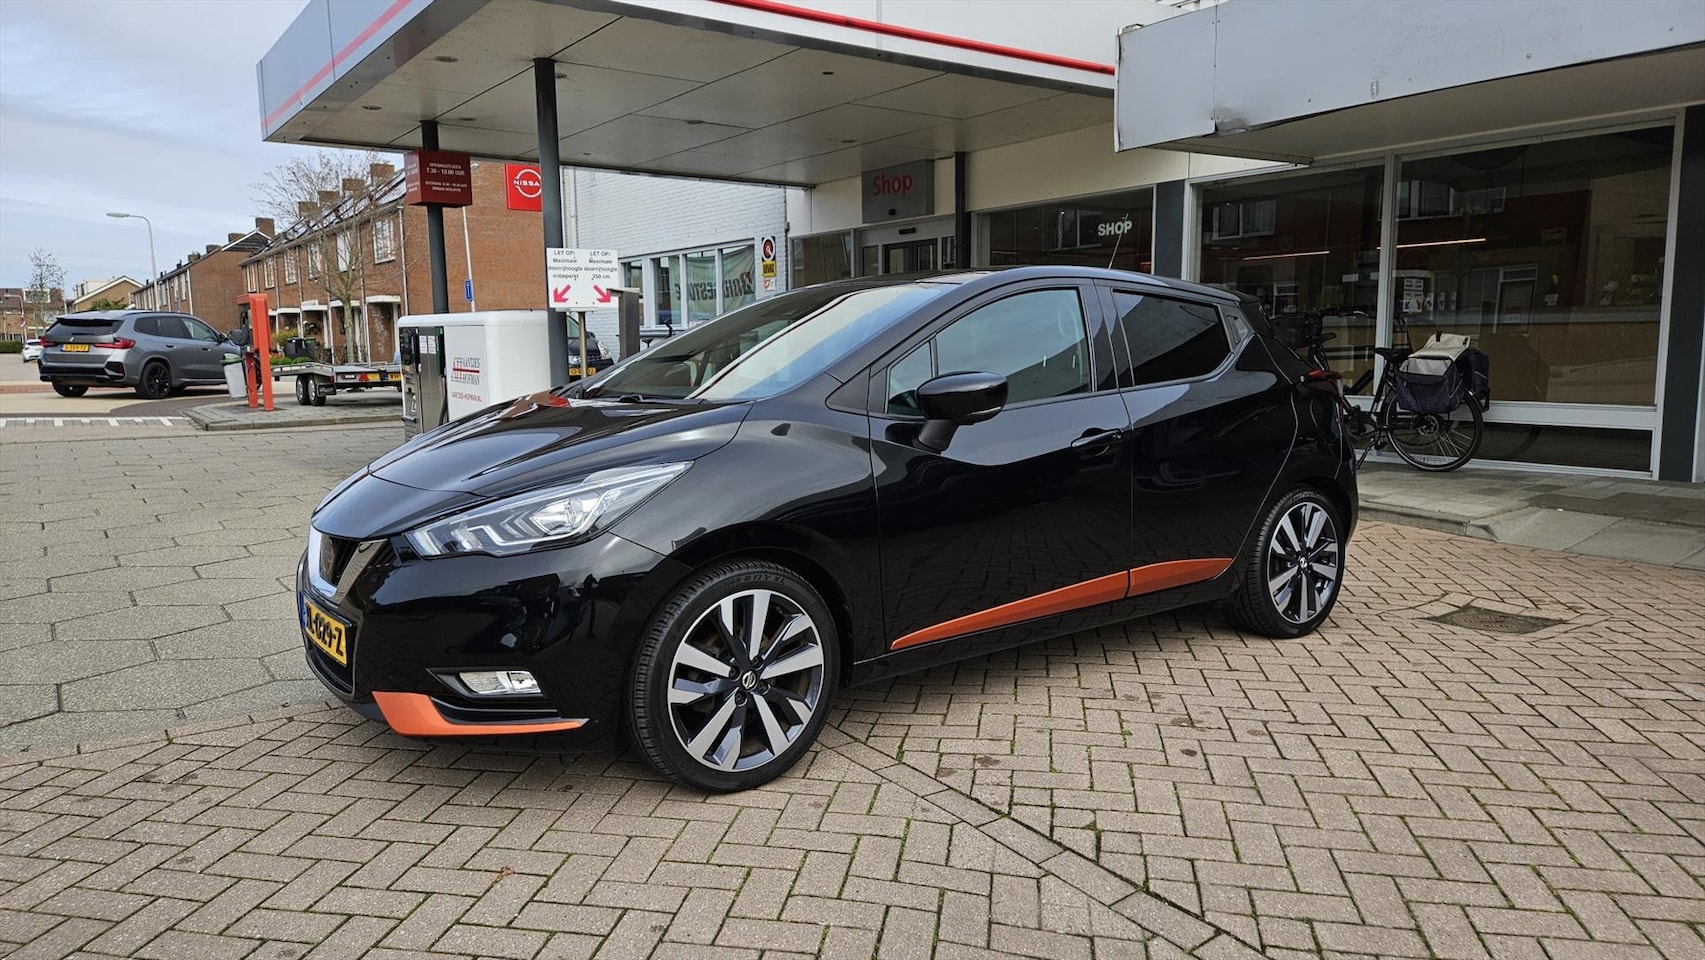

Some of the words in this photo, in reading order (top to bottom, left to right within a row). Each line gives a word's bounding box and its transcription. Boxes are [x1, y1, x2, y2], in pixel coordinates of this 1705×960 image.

[513, 179, 540, 187] NISSA
[873, 172, 913, 197] Shop
[1097, 220, 1133, 237] SHOP
[305, 602, 344, 657] L-029-Z
